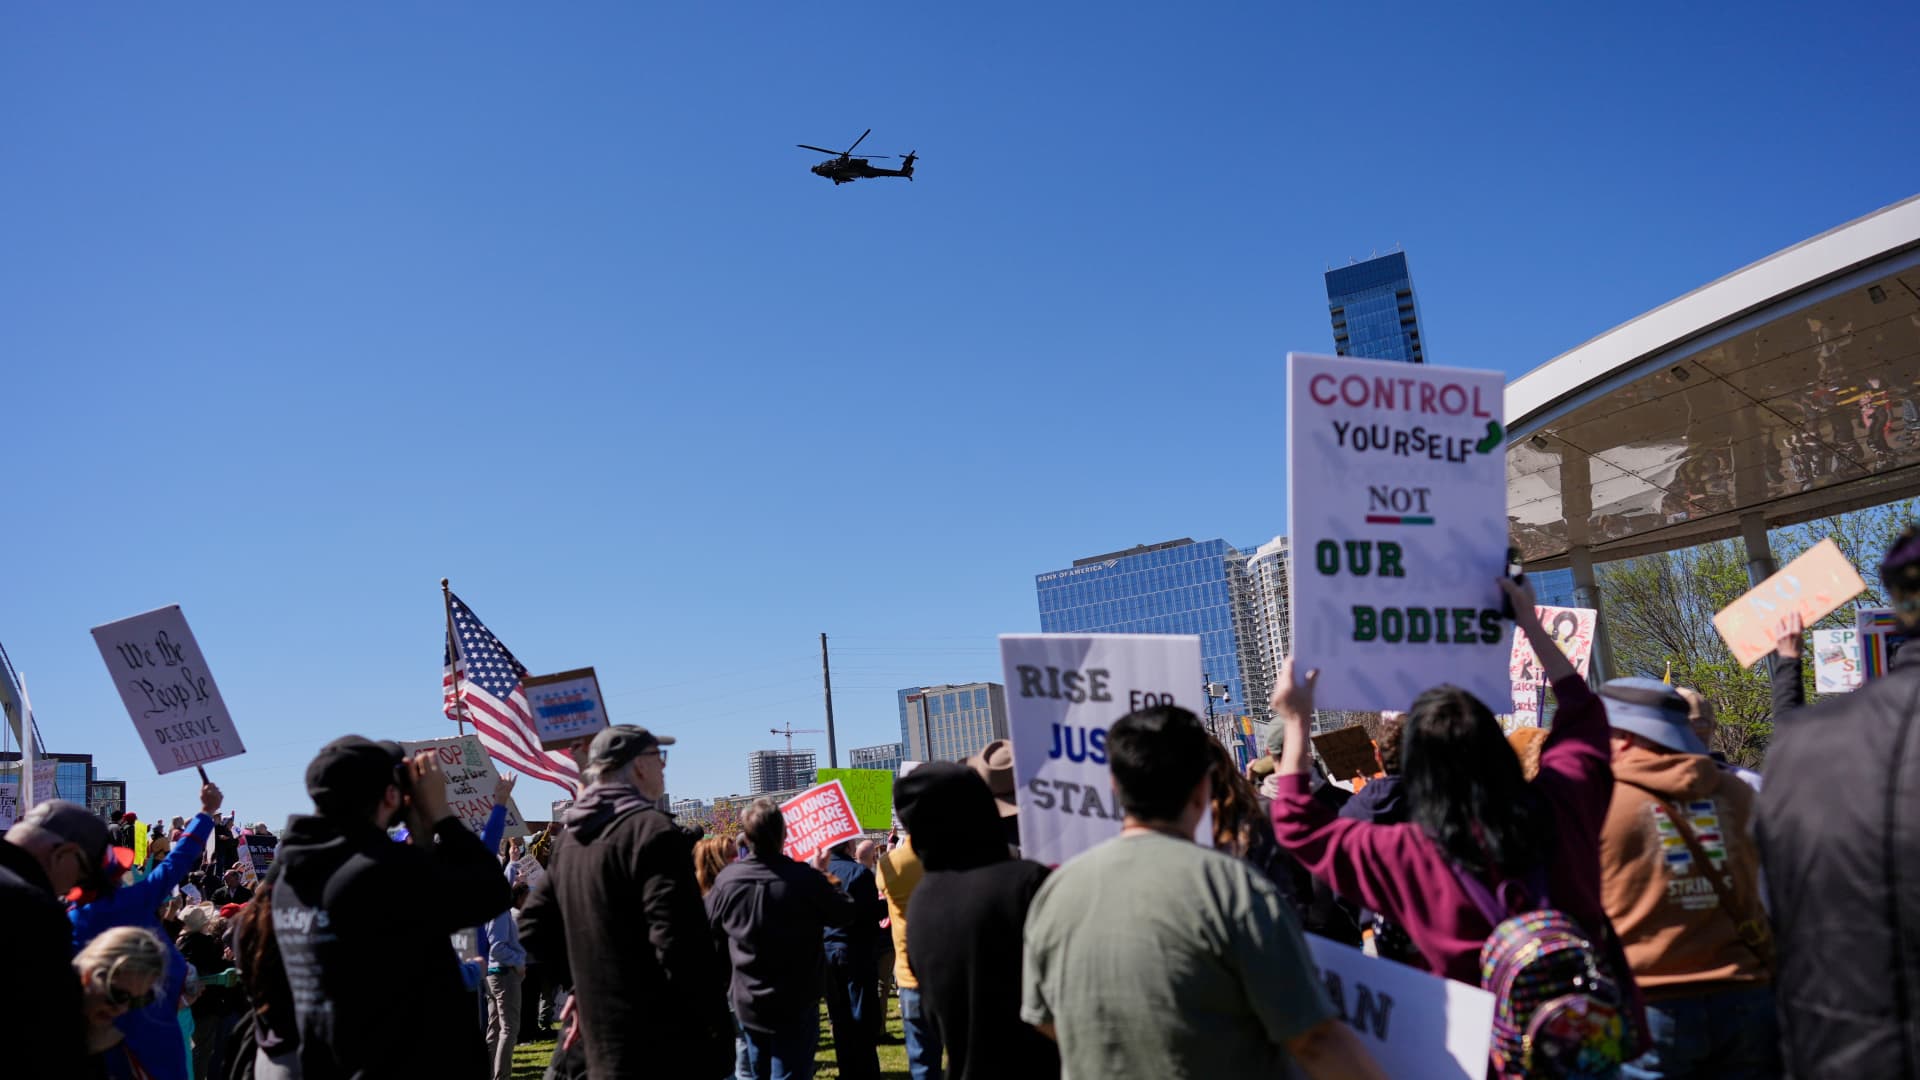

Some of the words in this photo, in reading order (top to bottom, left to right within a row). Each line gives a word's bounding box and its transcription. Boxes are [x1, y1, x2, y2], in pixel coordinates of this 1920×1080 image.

[1309, 373, 1492, 418] CONTROL
[1332, 420, 1473, 464] YOURSELF
[1368, 485, 1430, 513] NOT
[1038, 574, 1057, 582] BANK
[1059, 570, 1068, 578] OF
[1069, 565, 1103, 576] AMERICA
[1315, 539, 1406, 578] OUR
[1352, 605, 1503, 645] BODIES
[130, 666, 211, 719] People
[1016, 664, 1113, 704] RISE
[154, 716, 220, 745] DESERVE
[1048, 722, 1110, 765] JUS
[172, 739, 225, 765] BETTER
[783, 806, 803, 826] NO
[800, 788, 840, 815] KINGS
[1027, 776, 1124, 821] STA
[785, 802, 847, 842] LTHCARE
[793, 818, 853, 855] WARFARE
[1316, 966, 1395, 1044] AN
